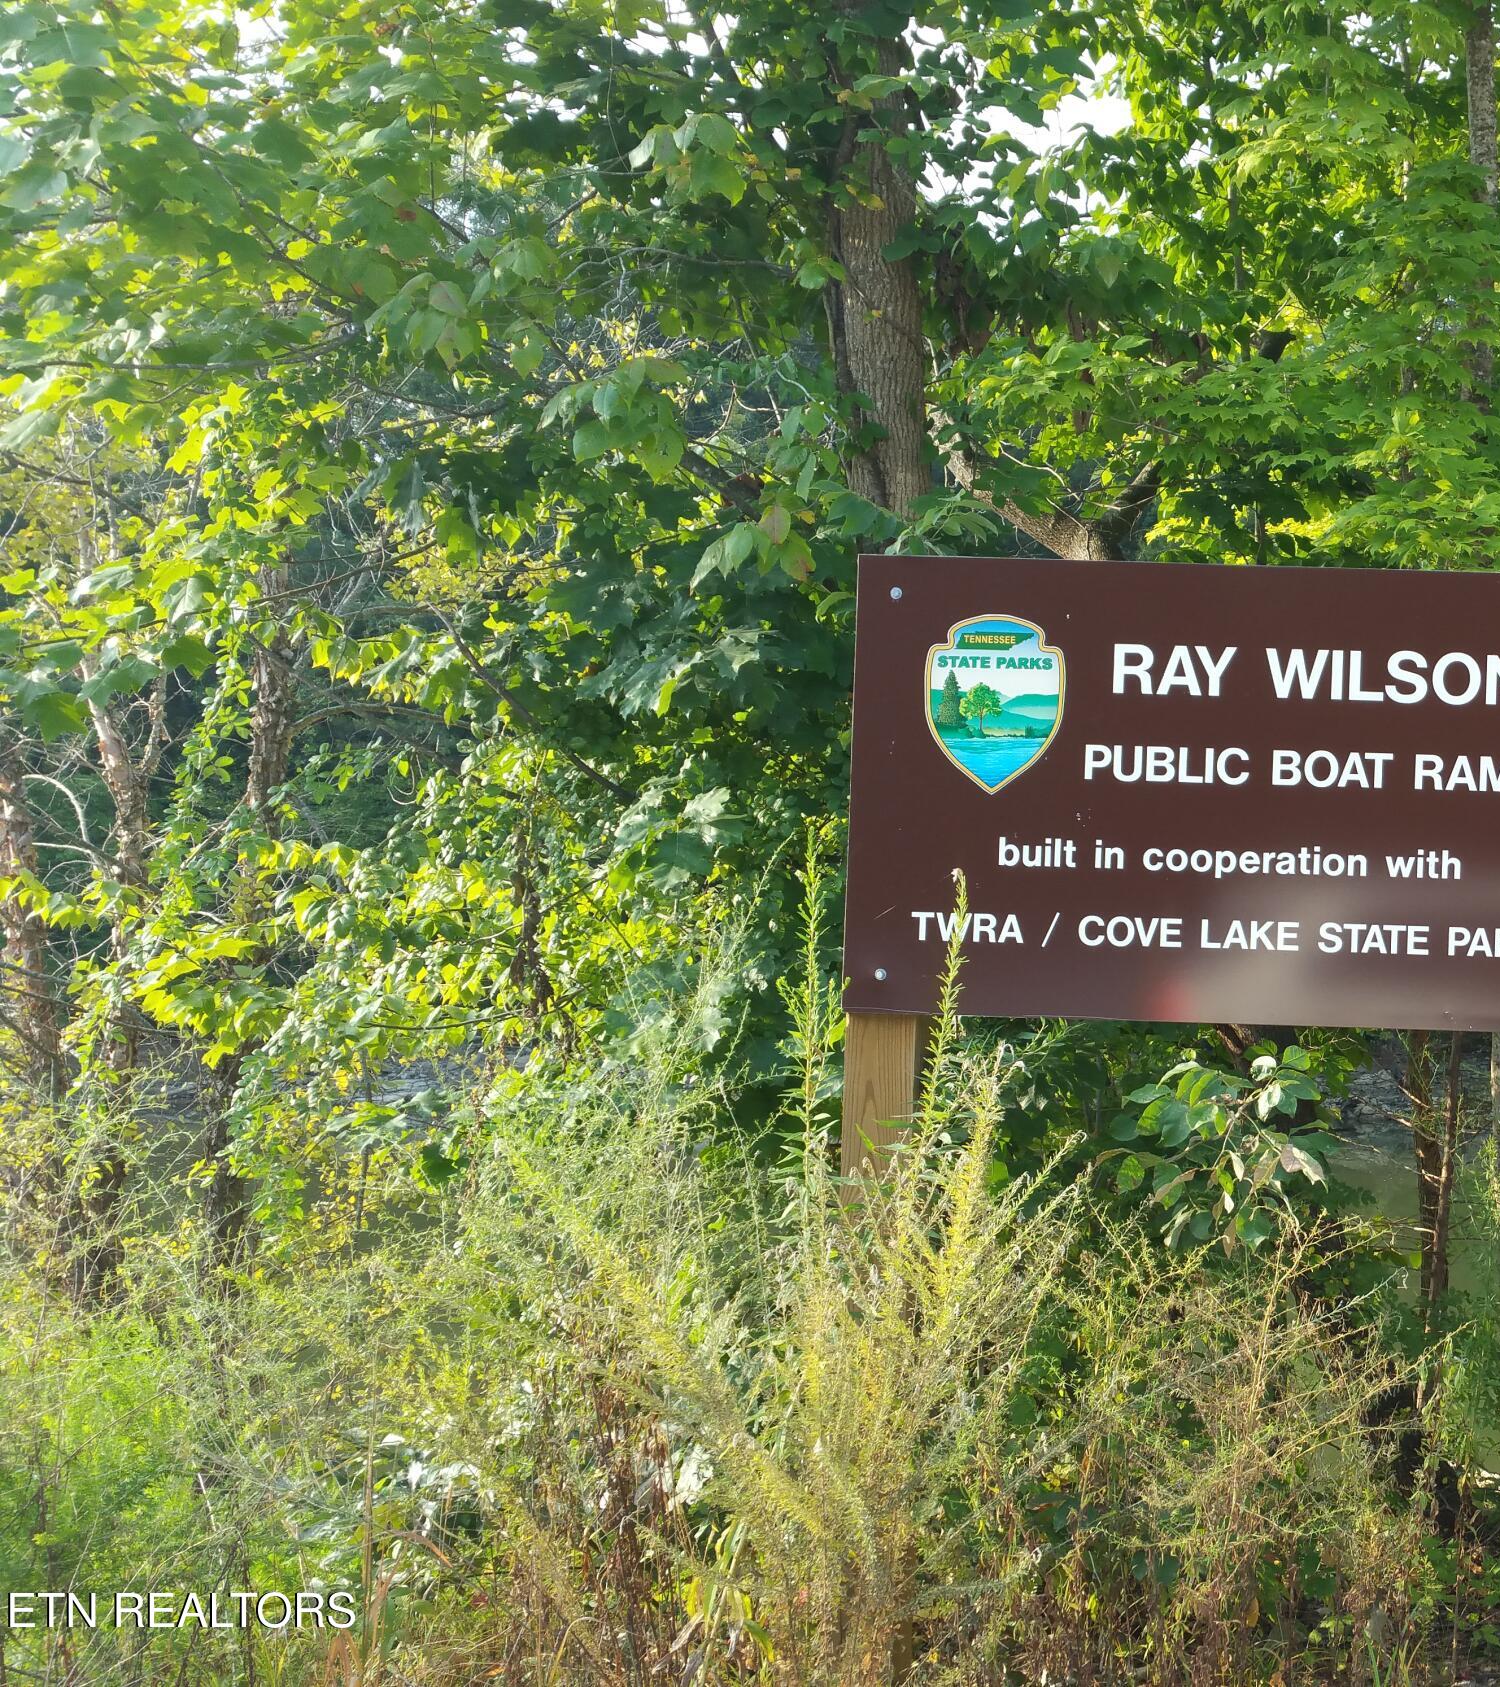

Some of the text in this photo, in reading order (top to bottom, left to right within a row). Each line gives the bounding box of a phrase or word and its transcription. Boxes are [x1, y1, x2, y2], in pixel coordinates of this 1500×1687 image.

[964, 635, 1016, 644] TENNESSEE
[937, 655, 1053, 670] STATE PARKS
[1113, 644, 1237, 696] RAY
[1085, 745, 1249, 785] PUBLIC
[1272, 750, 1393, 788] BOAT
[999, 837, 1461, 879] built in cooperation with
[911, 911, 1024, 944] TWRA
[1042, 912, 1060, 947] /
[1079, 916, 1182, 947] COVE
[1201, 919, 1299, 951] LAKE
[1318, 922, 1429, 955] STATE
